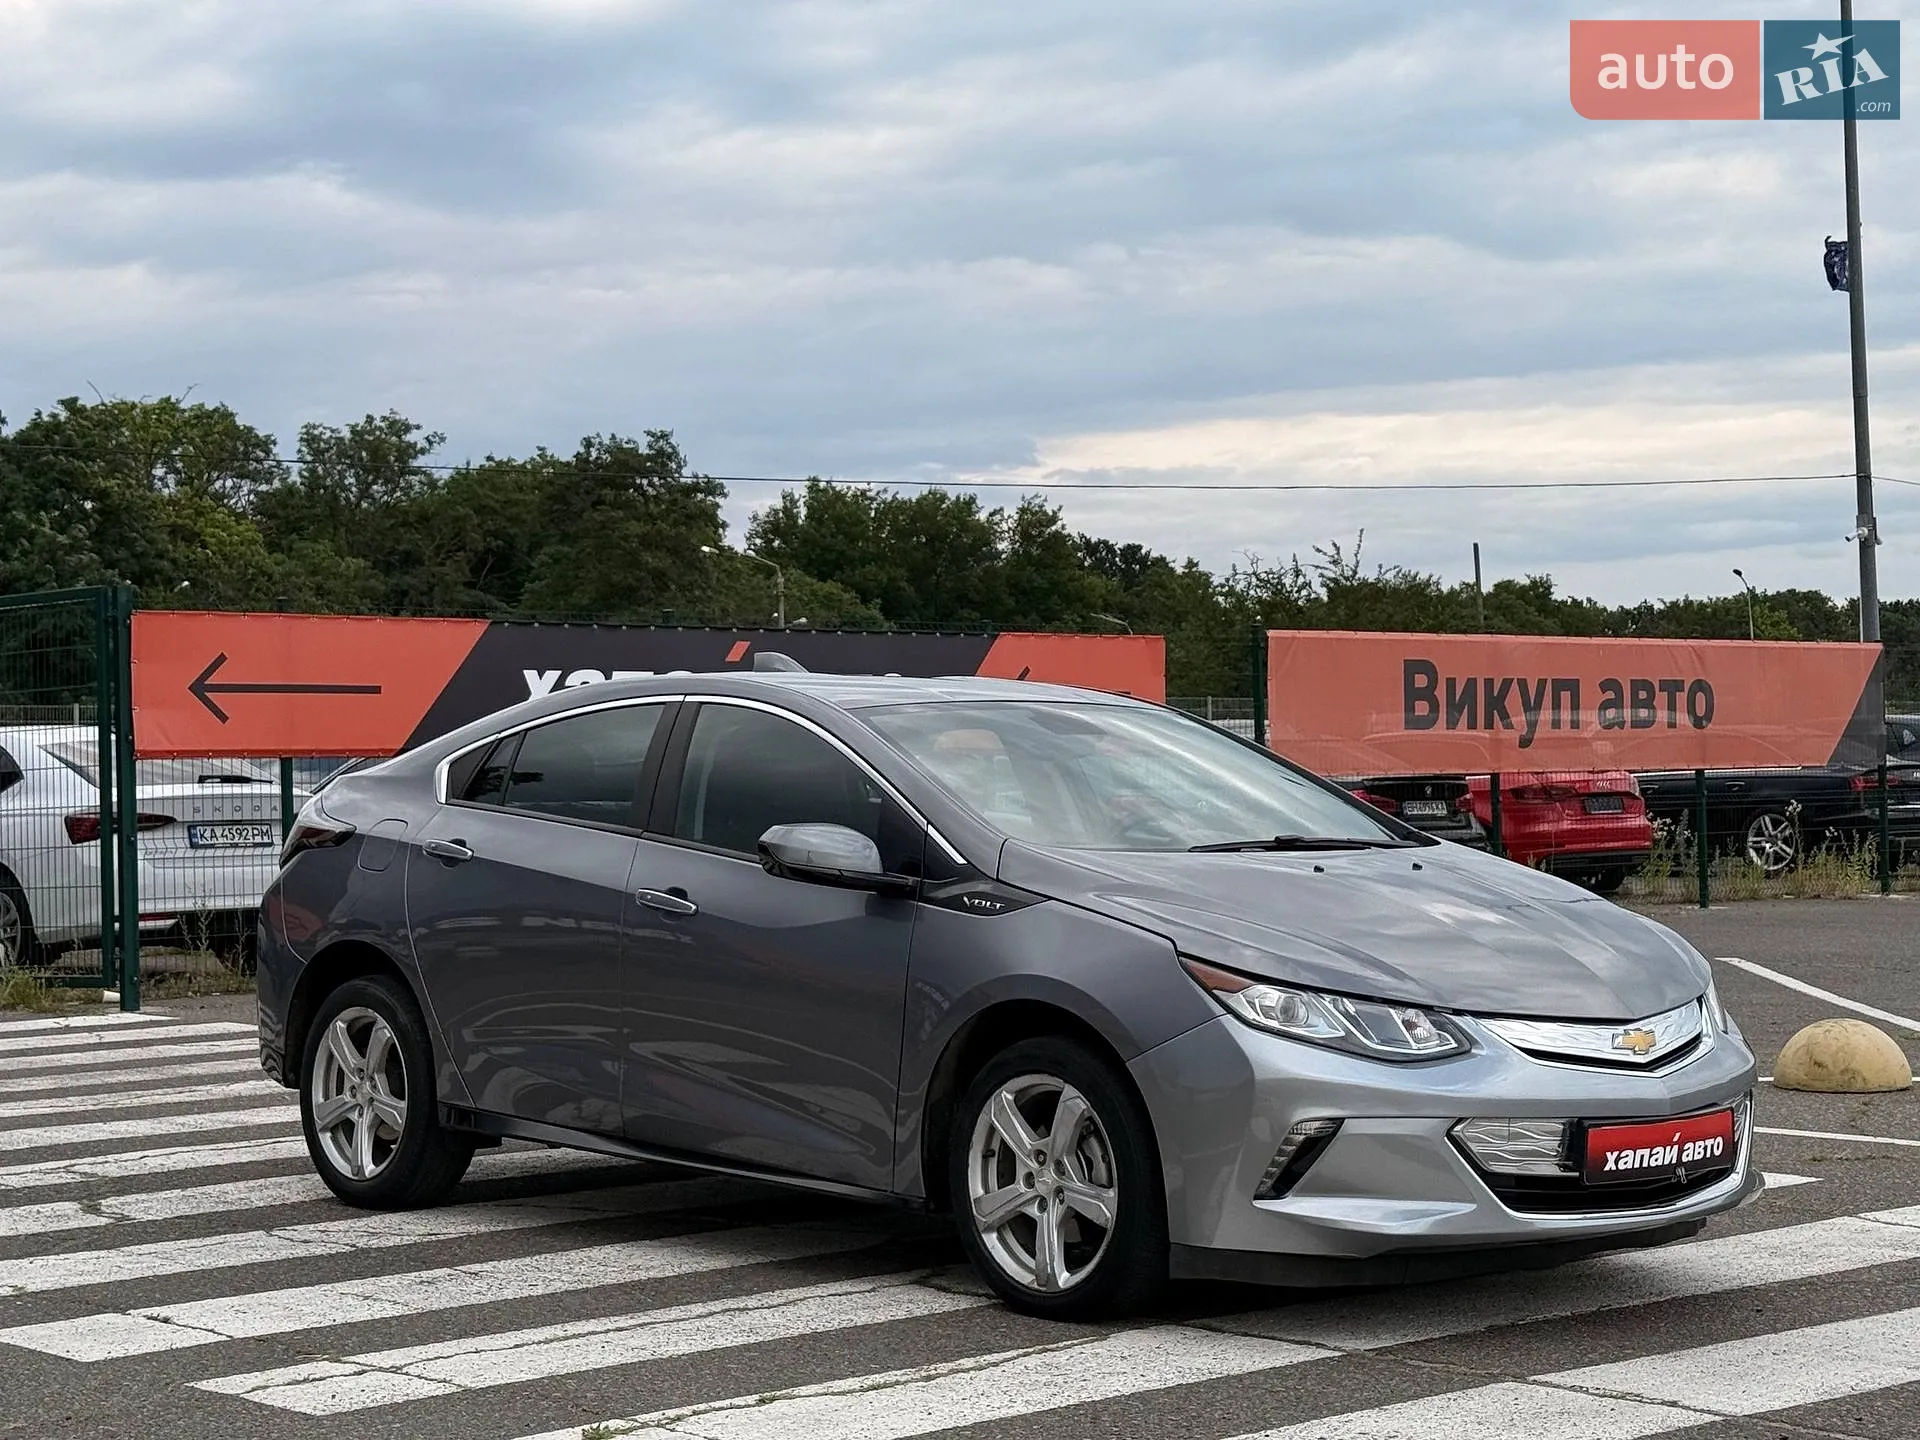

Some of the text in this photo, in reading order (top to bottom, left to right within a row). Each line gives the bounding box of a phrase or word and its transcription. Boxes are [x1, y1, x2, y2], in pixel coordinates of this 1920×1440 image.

[1403, 658, 1715, 749] Викуп авто
[963, 895, 1006, 910] VOLT
[1681, 1136, 1724, 1160] авто
